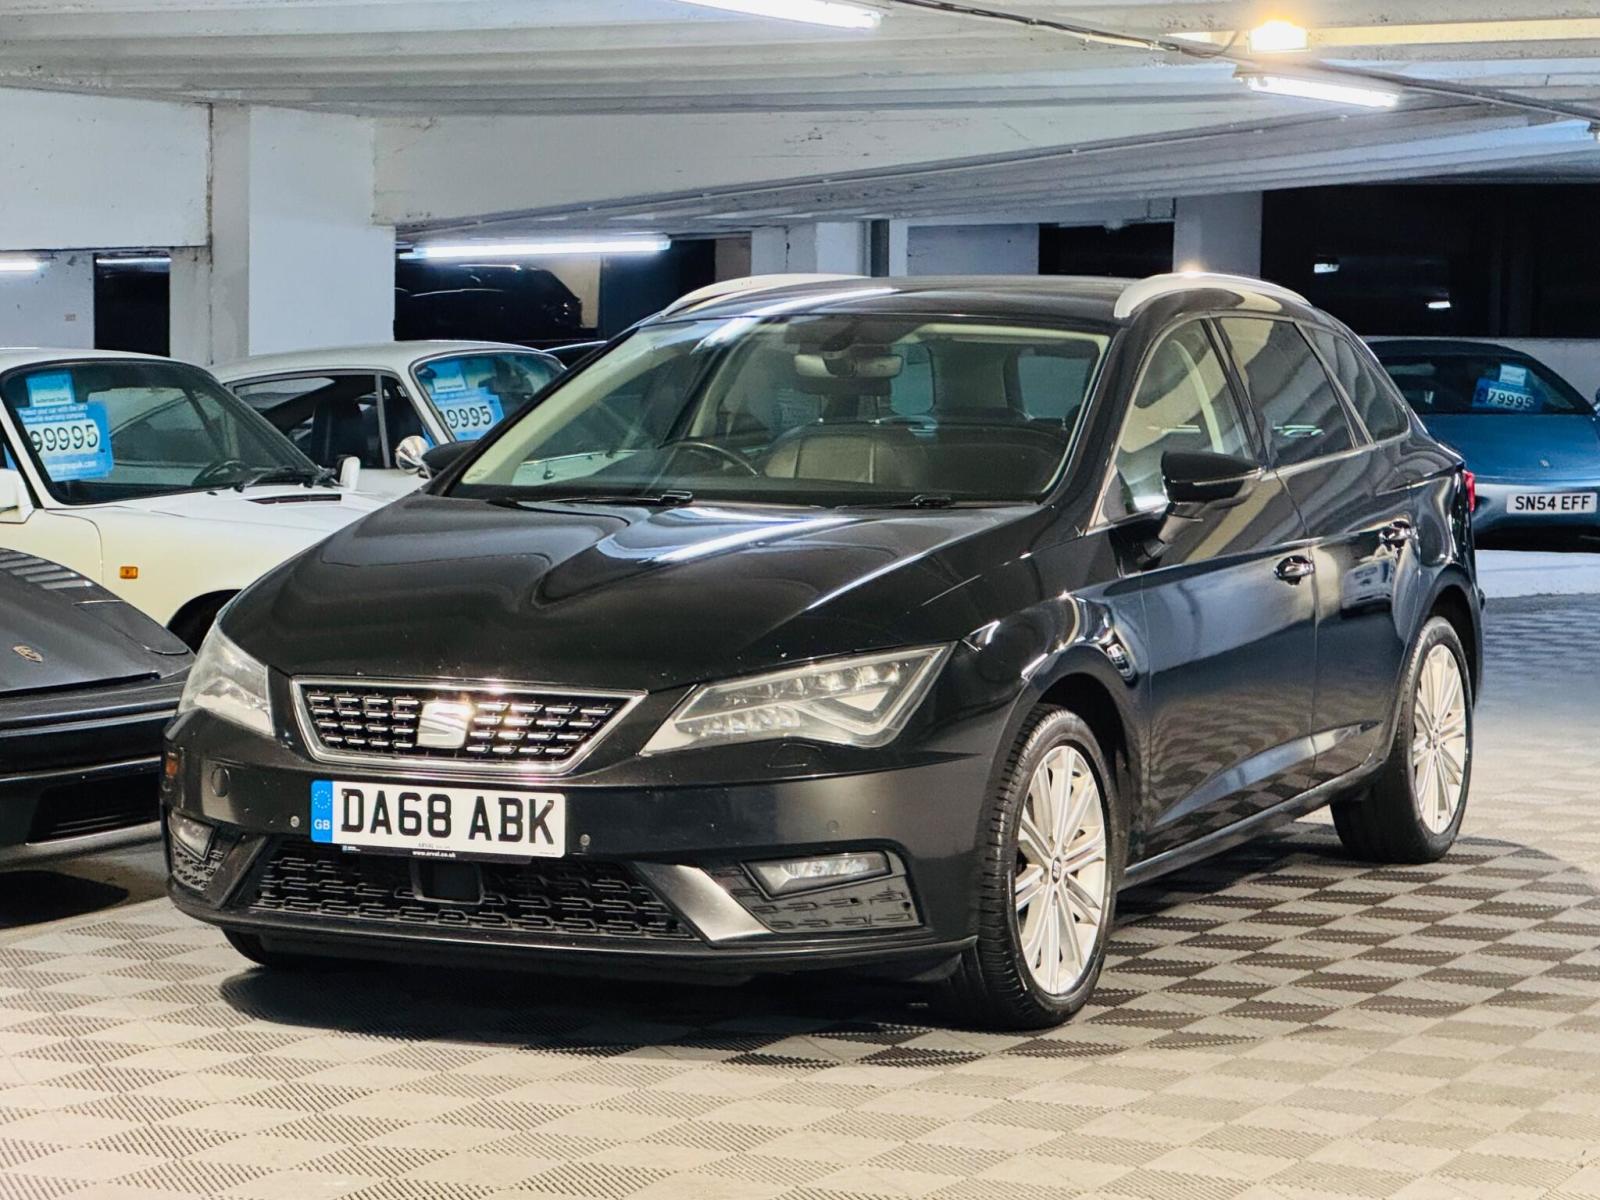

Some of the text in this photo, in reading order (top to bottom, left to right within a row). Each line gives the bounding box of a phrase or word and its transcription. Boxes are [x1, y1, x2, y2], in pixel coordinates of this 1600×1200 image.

[440, 405, 492, 429] 9995
[1515, 495, 1591, 510] SN54 EFF
[314, 819, 330, 830] GB
[341, 788, 554, 844] DA68 ABK
